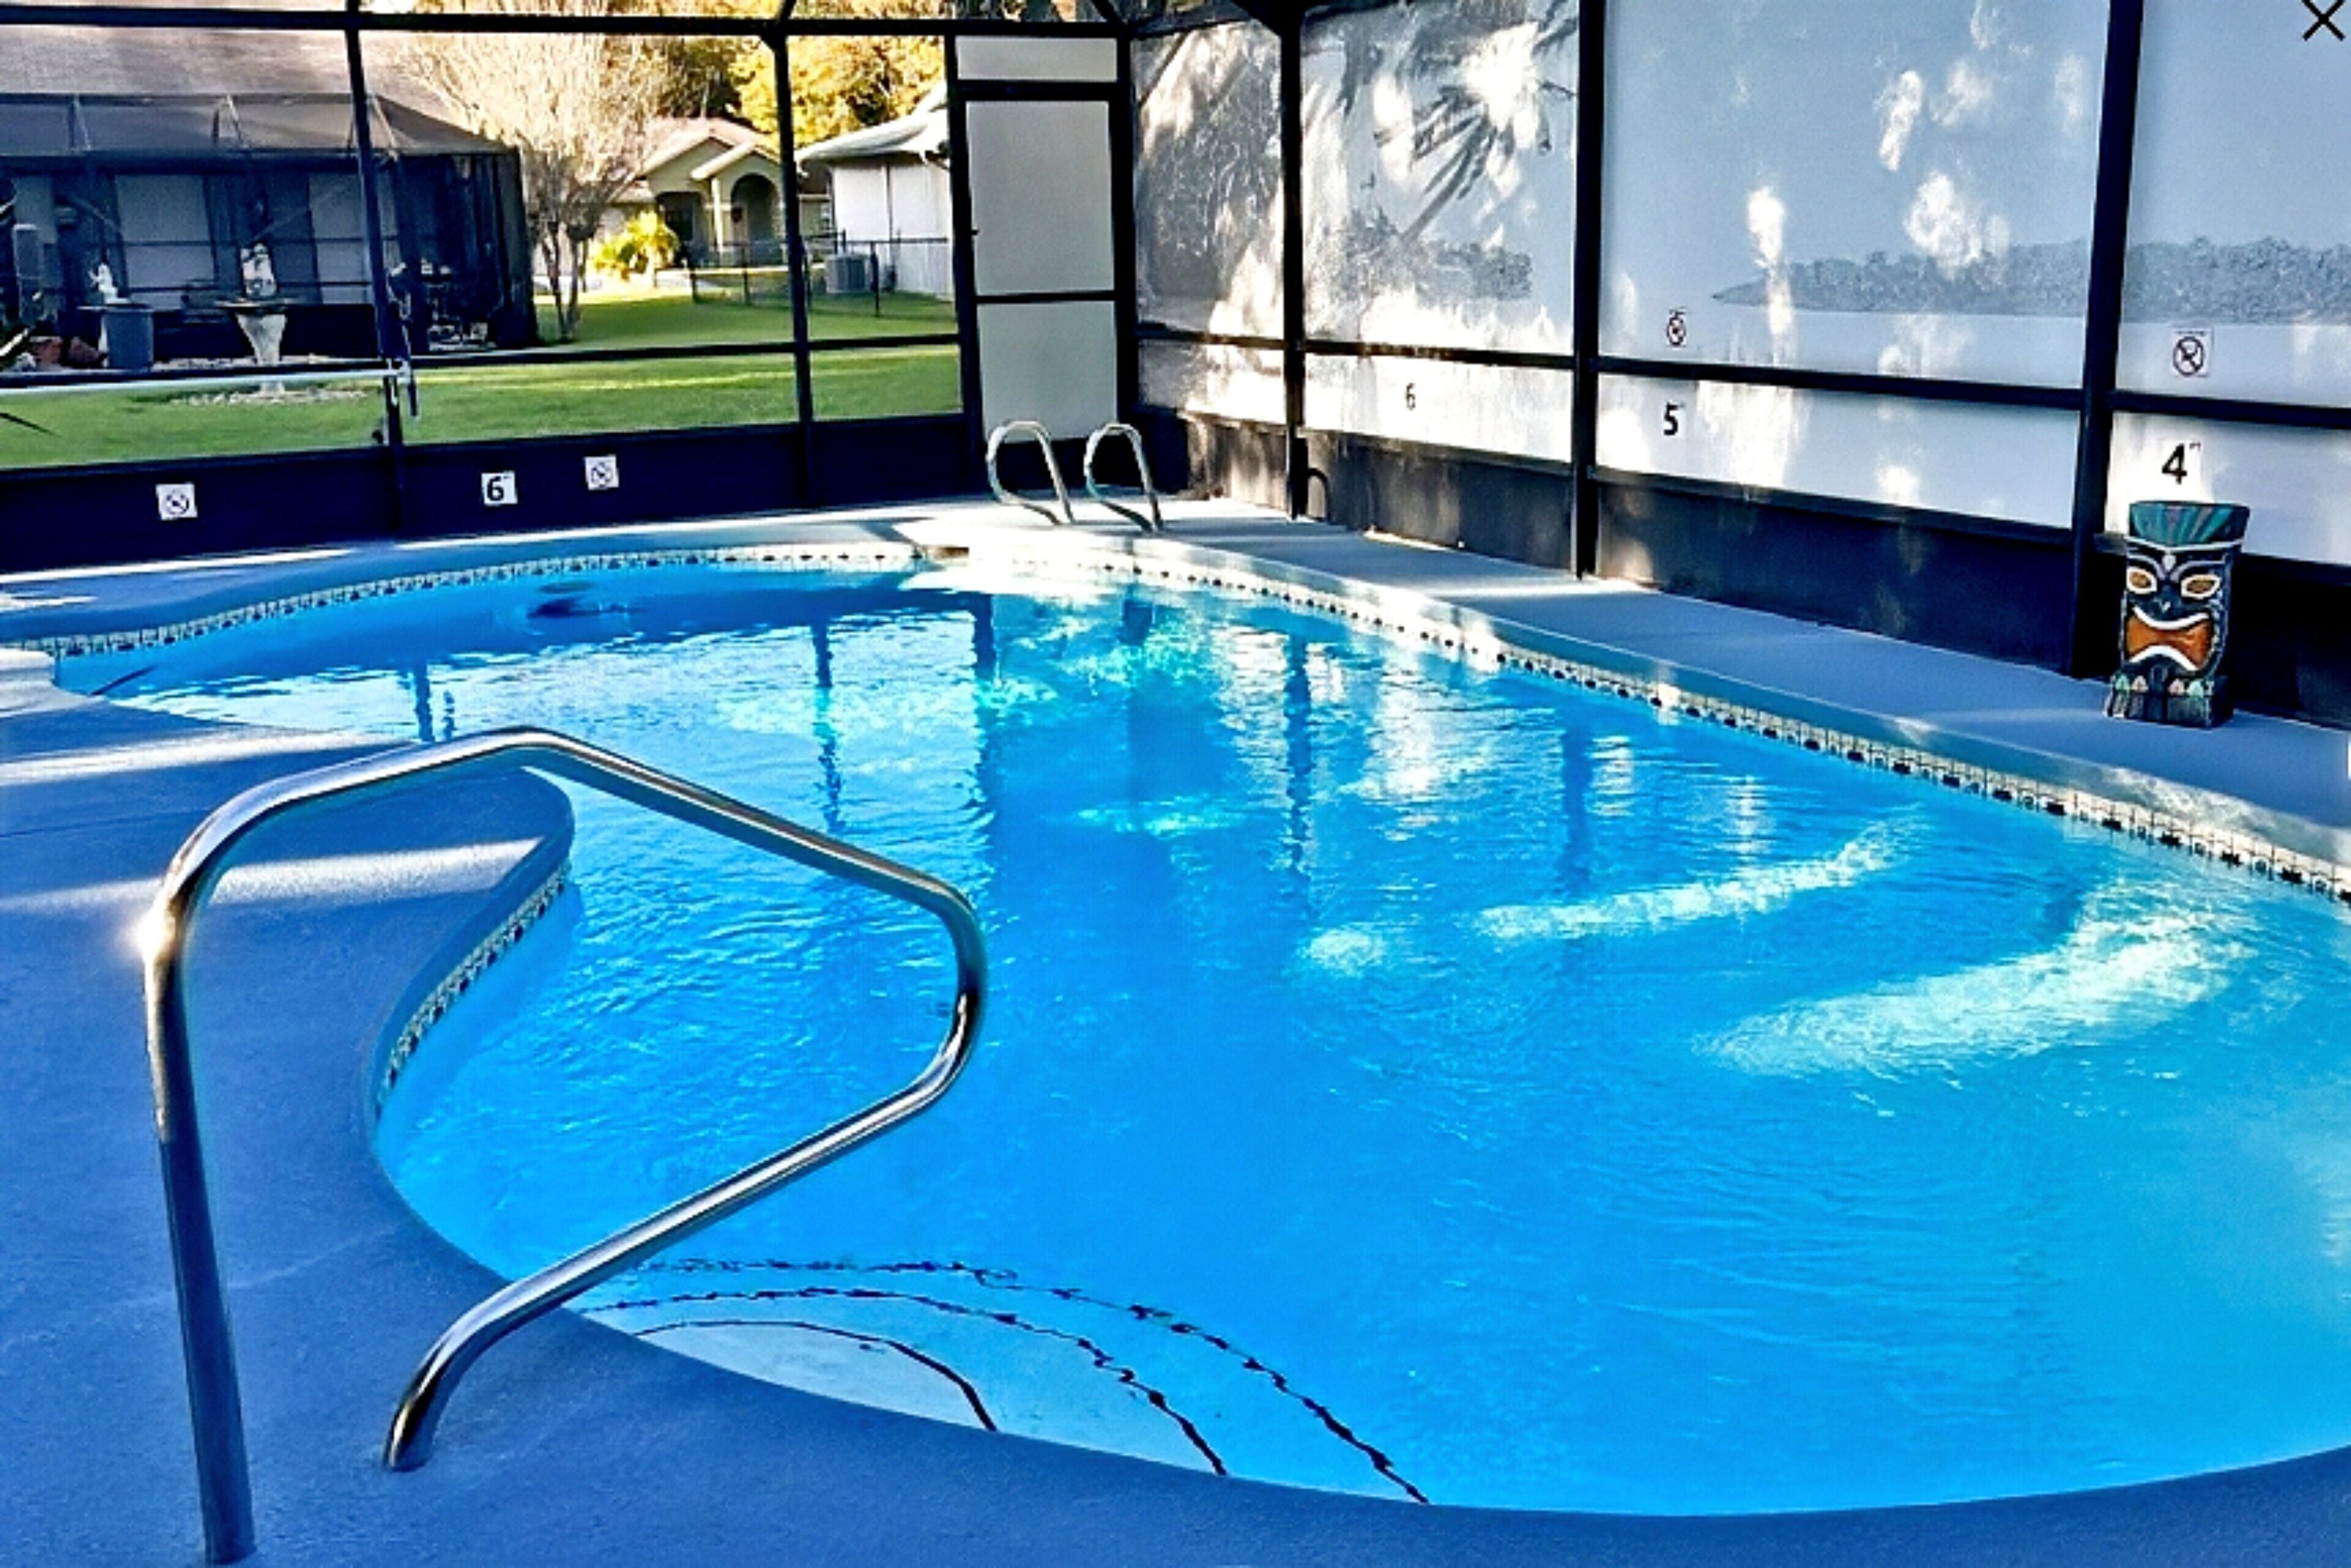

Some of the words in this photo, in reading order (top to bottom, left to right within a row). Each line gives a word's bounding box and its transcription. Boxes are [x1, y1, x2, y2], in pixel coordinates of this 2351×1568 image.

[1406, 382, 1416, 411] 6
[1664, 402, 1678, 435] 5
[2162, 443, 2188, 485] 4
[487, 476, 504, 501] 6
